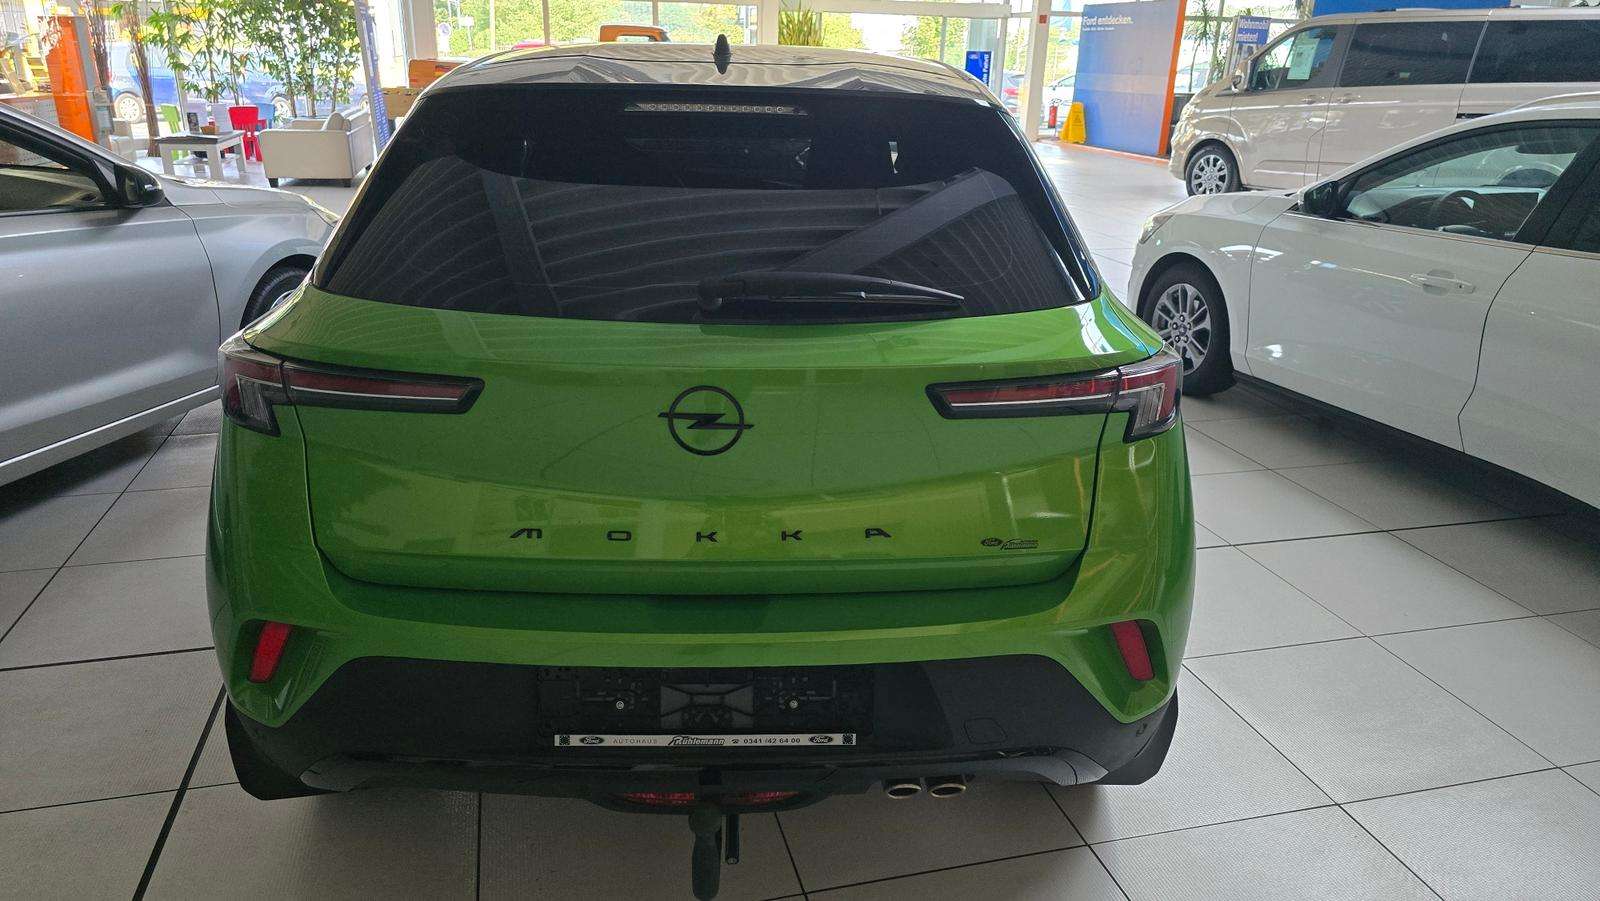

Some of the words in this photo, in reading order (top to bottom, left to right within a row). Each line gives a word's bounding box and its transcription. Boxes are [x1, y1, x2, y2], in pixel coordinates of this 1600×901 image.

[1082, 16, 1097, 26] Ford
[1097, 15, 1134, 25] entdecken.
[510, 528, 891, 543] MOKKA
